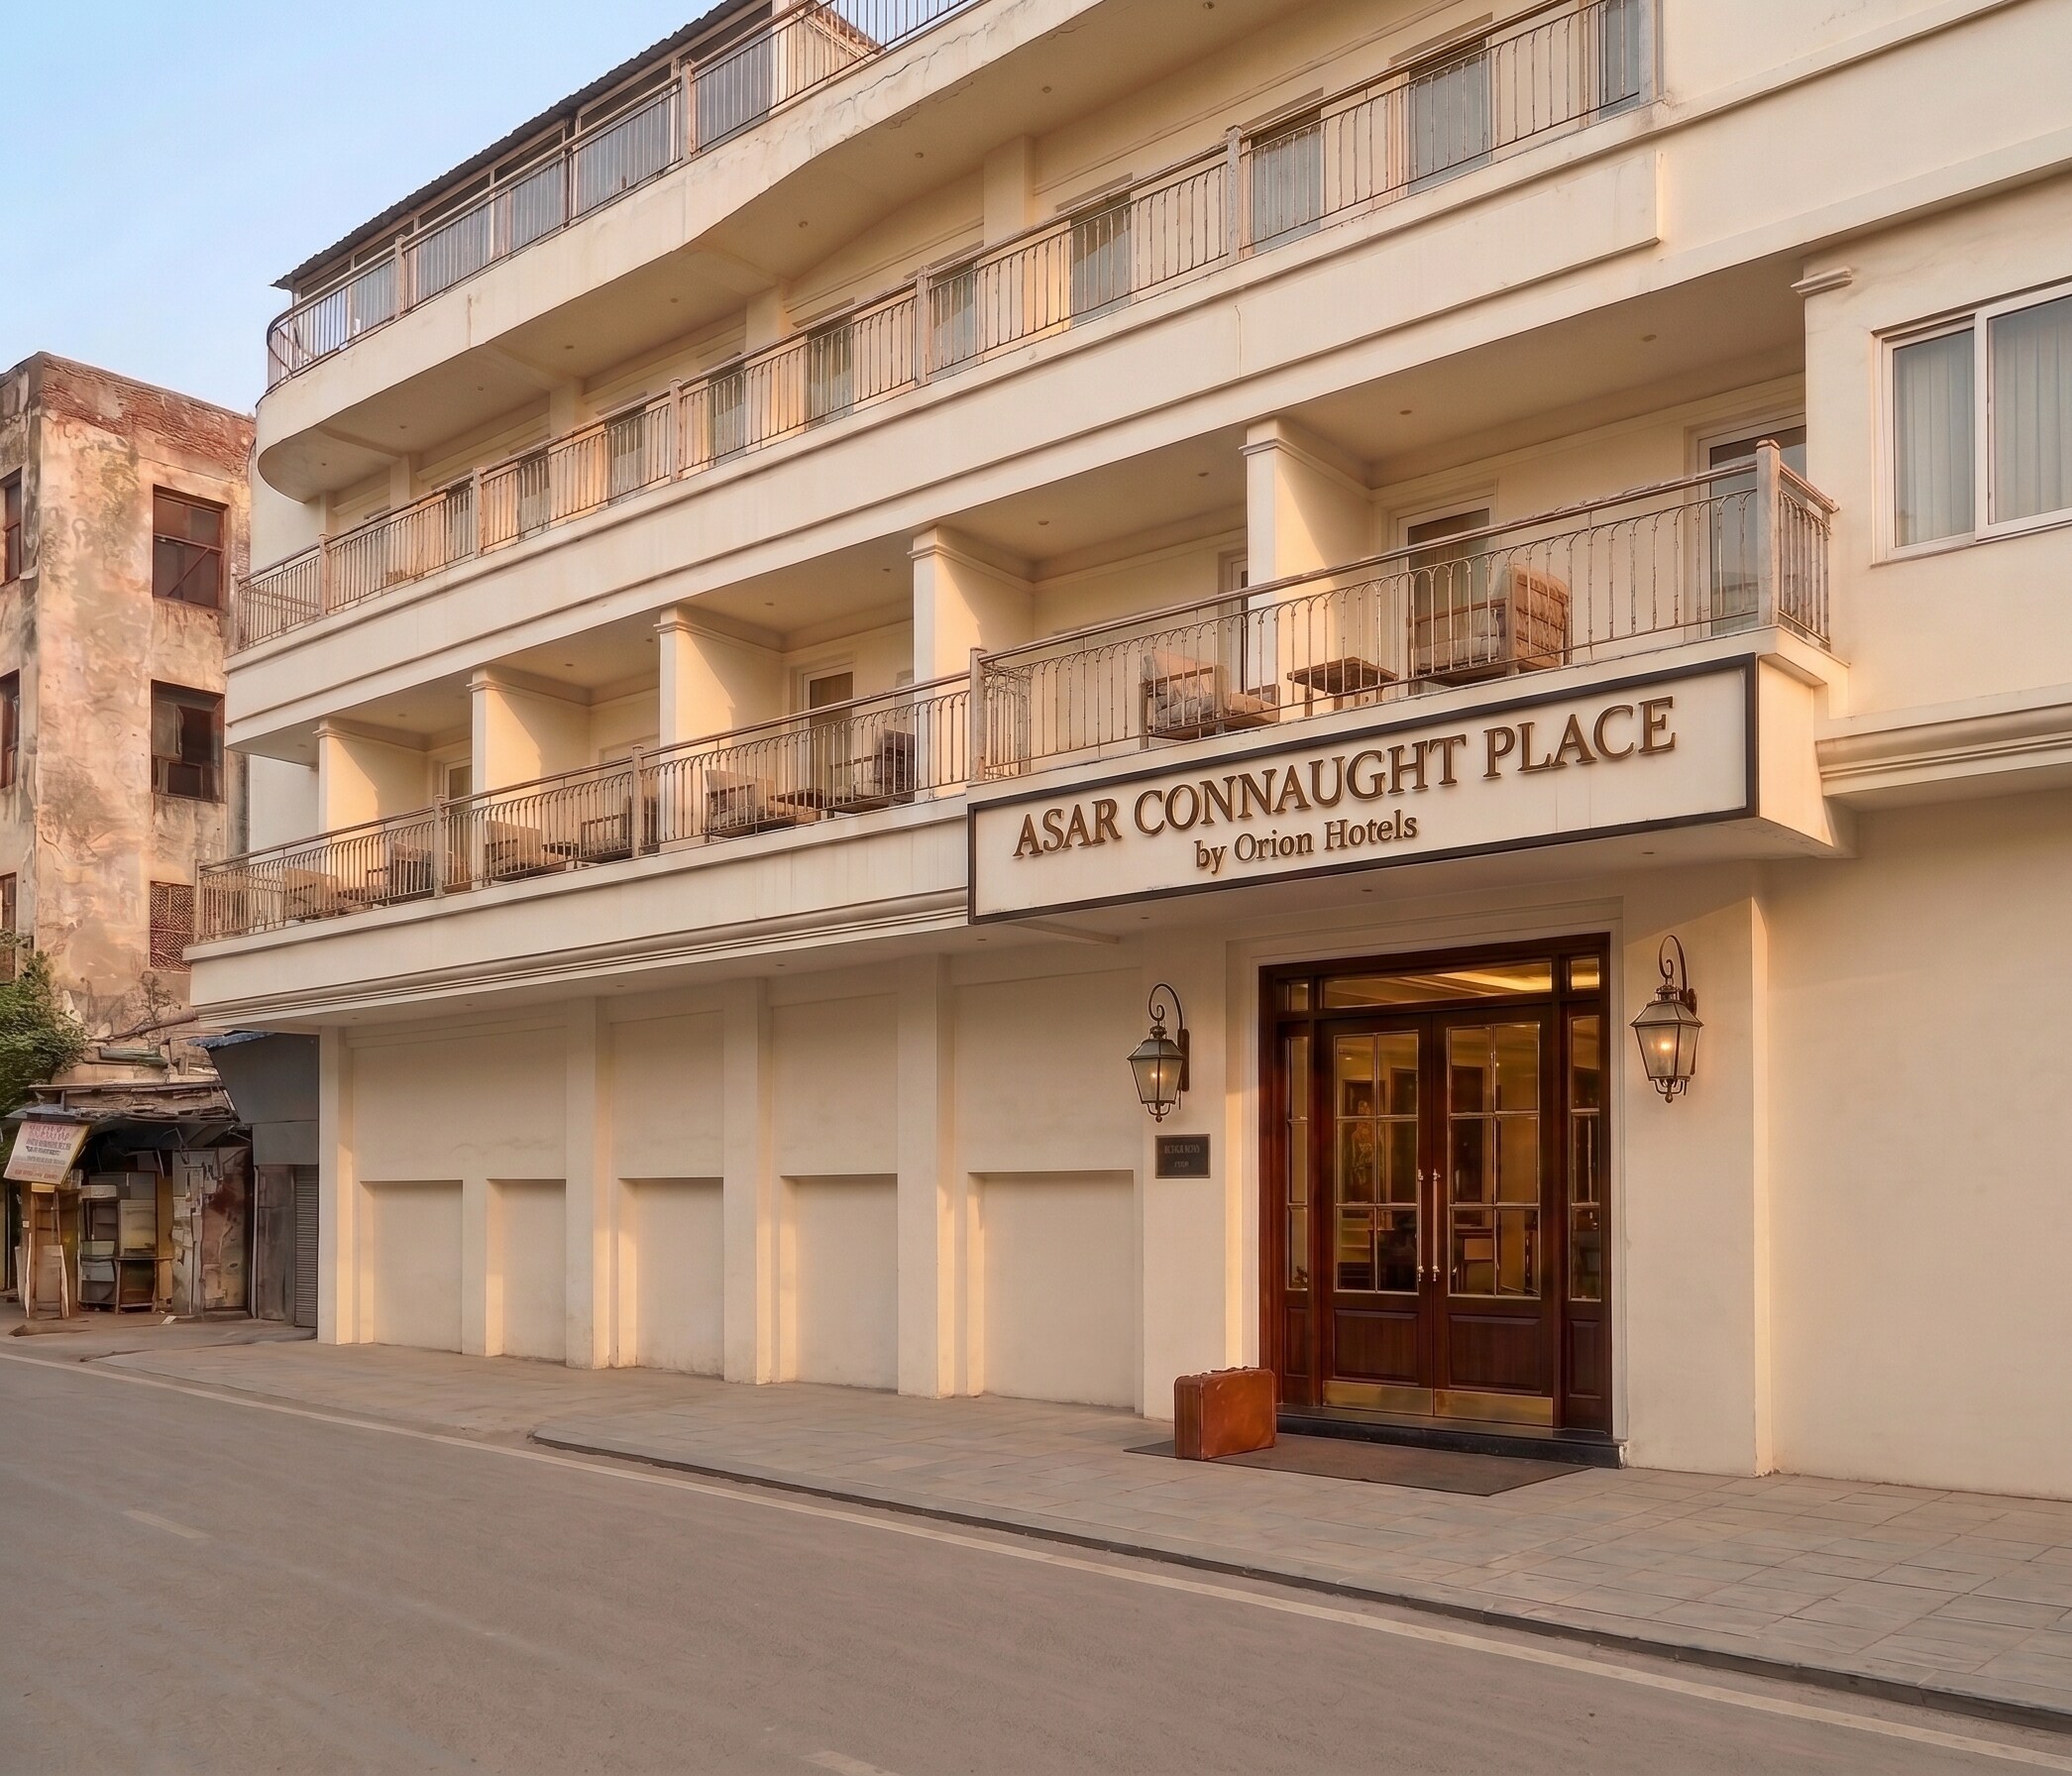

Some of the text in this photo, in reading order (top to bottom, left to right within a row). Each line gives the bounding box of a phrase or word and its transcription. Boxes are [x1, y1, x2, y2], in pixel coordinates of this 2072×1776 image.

[1013, 696, 1677, 859] ASAR CONNAUGHT PLACE
[1193, 809, 1418, 875] by Orion Hotels
